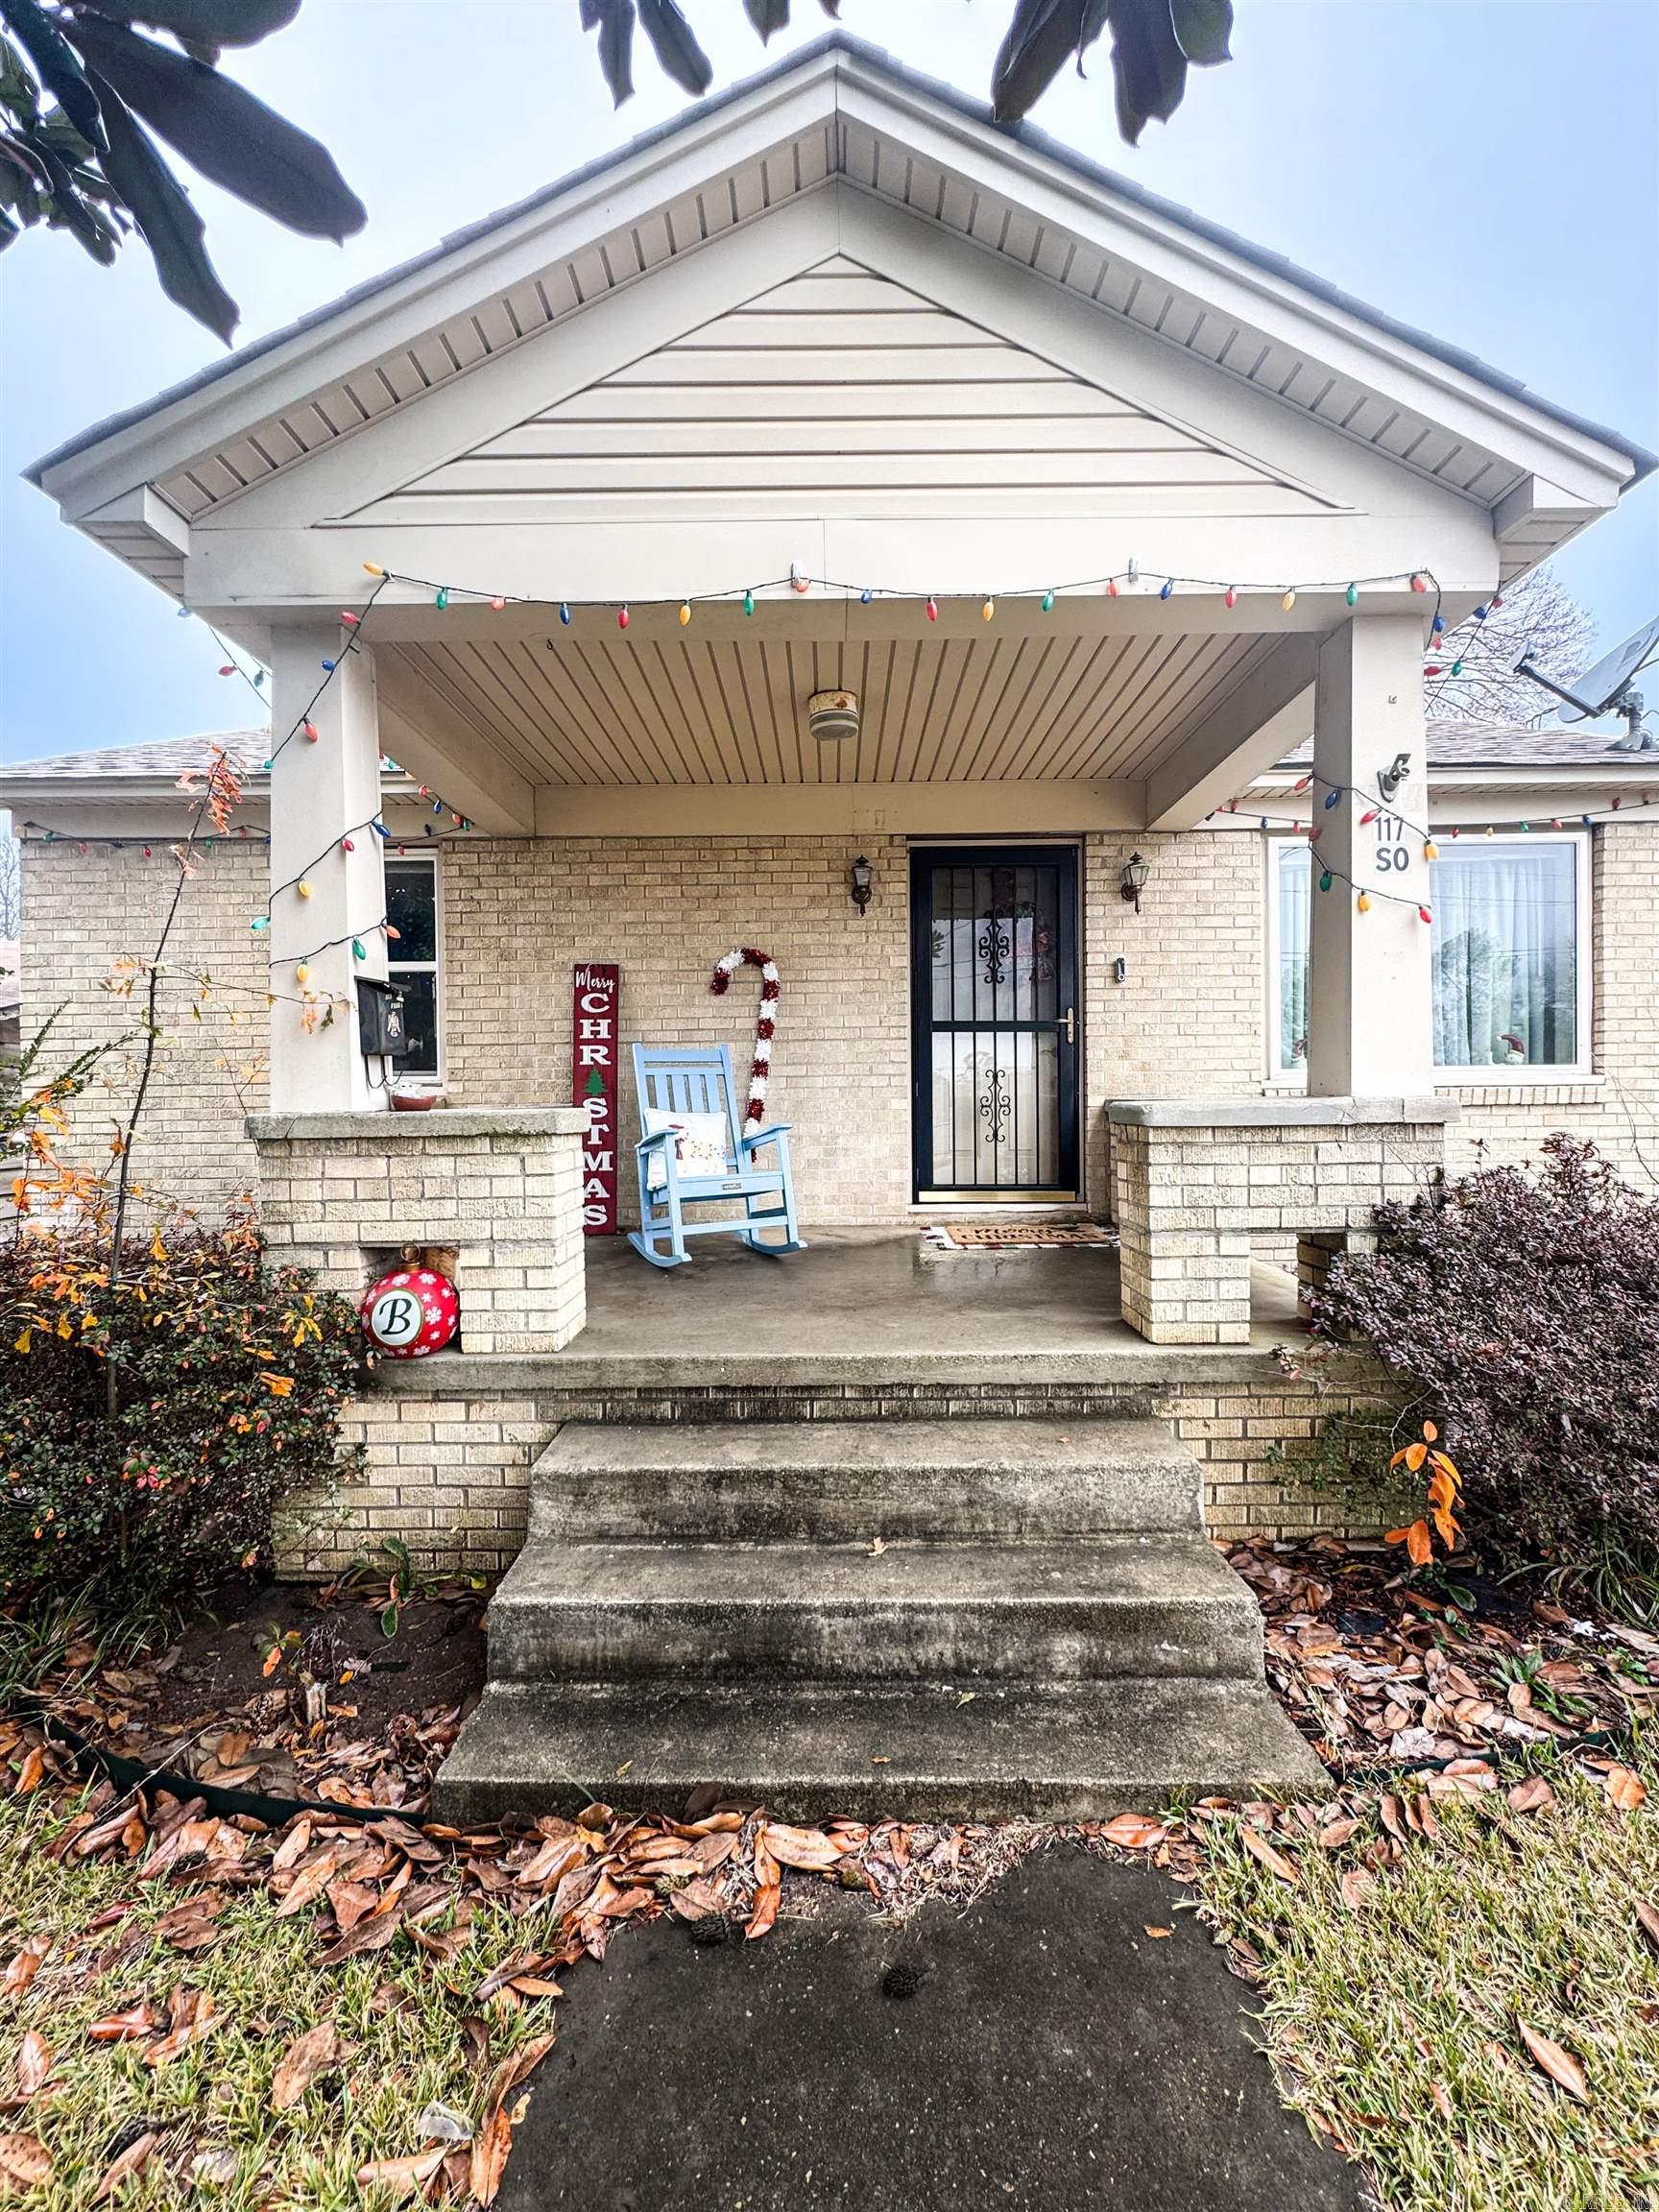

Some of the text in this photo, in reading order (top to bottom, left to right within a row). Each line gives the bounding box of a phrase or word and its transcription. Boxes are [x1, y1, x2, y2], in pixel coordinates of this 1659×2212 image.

[1376, 817, 1405, 841] 117
[576, 964, 614, 994] Merry
[379, 1299, 412, 1334] B
